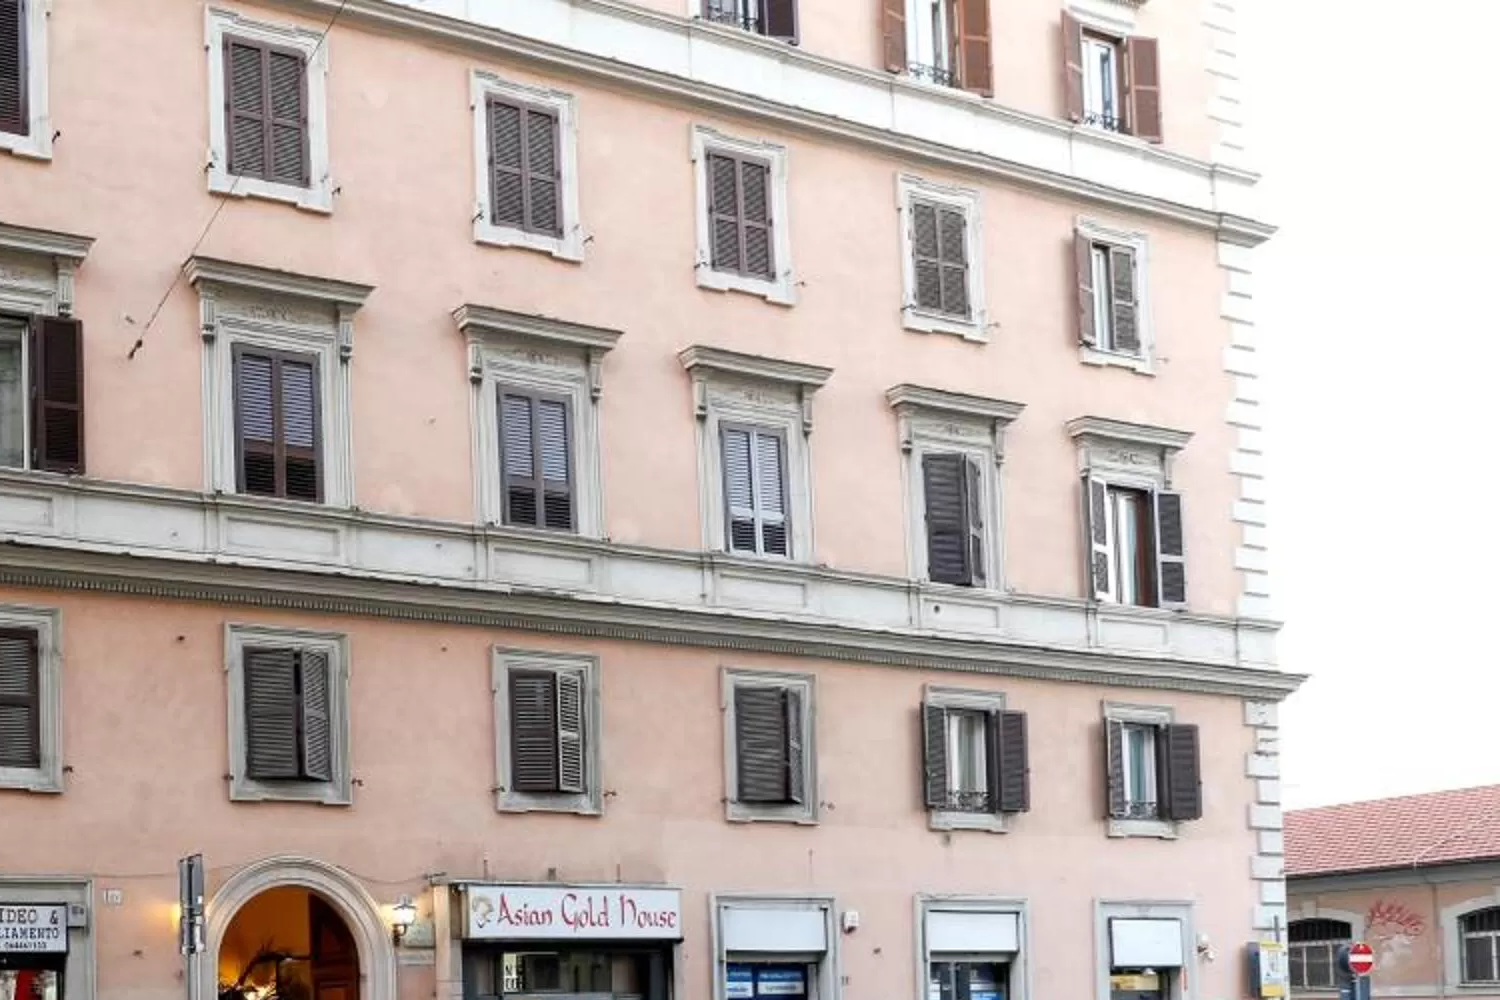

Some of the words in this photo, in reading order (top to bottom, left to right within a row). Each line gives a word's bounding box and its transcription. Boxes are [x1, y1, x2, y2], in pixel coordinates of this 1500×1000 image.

[49, 910, 59, 925] &
[497, 892, 553, 926] Asian
[561, 893, 609, 932] Gold
